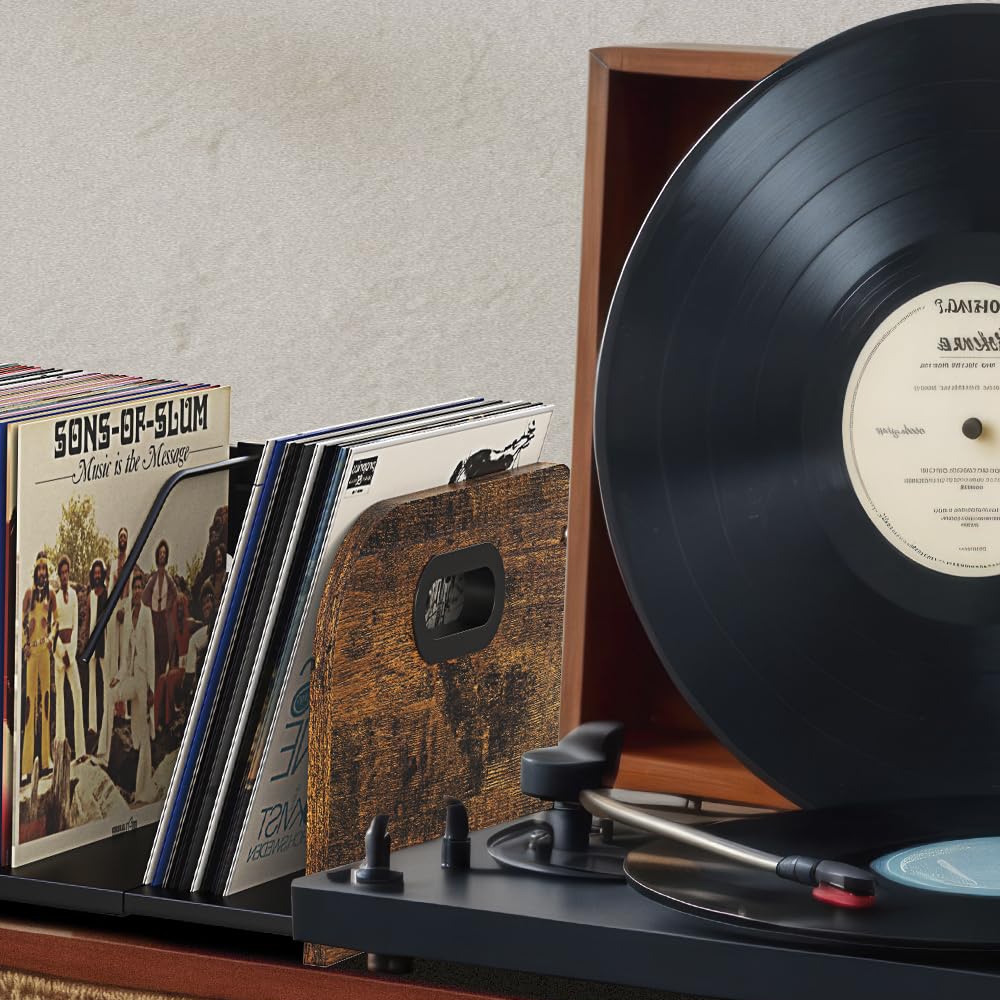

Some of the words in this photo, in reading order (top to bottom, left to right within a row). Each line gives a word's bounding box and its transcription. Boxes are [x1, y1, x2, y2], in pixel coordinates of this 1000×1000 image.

[54, 394, 208, 459] SONS-OF-SLUM
[71, 454, 112, 484] Music
[114, 451, 122, 476] is
[124, 449, 139, 473] the
[142, 442, 190, 470] Message
